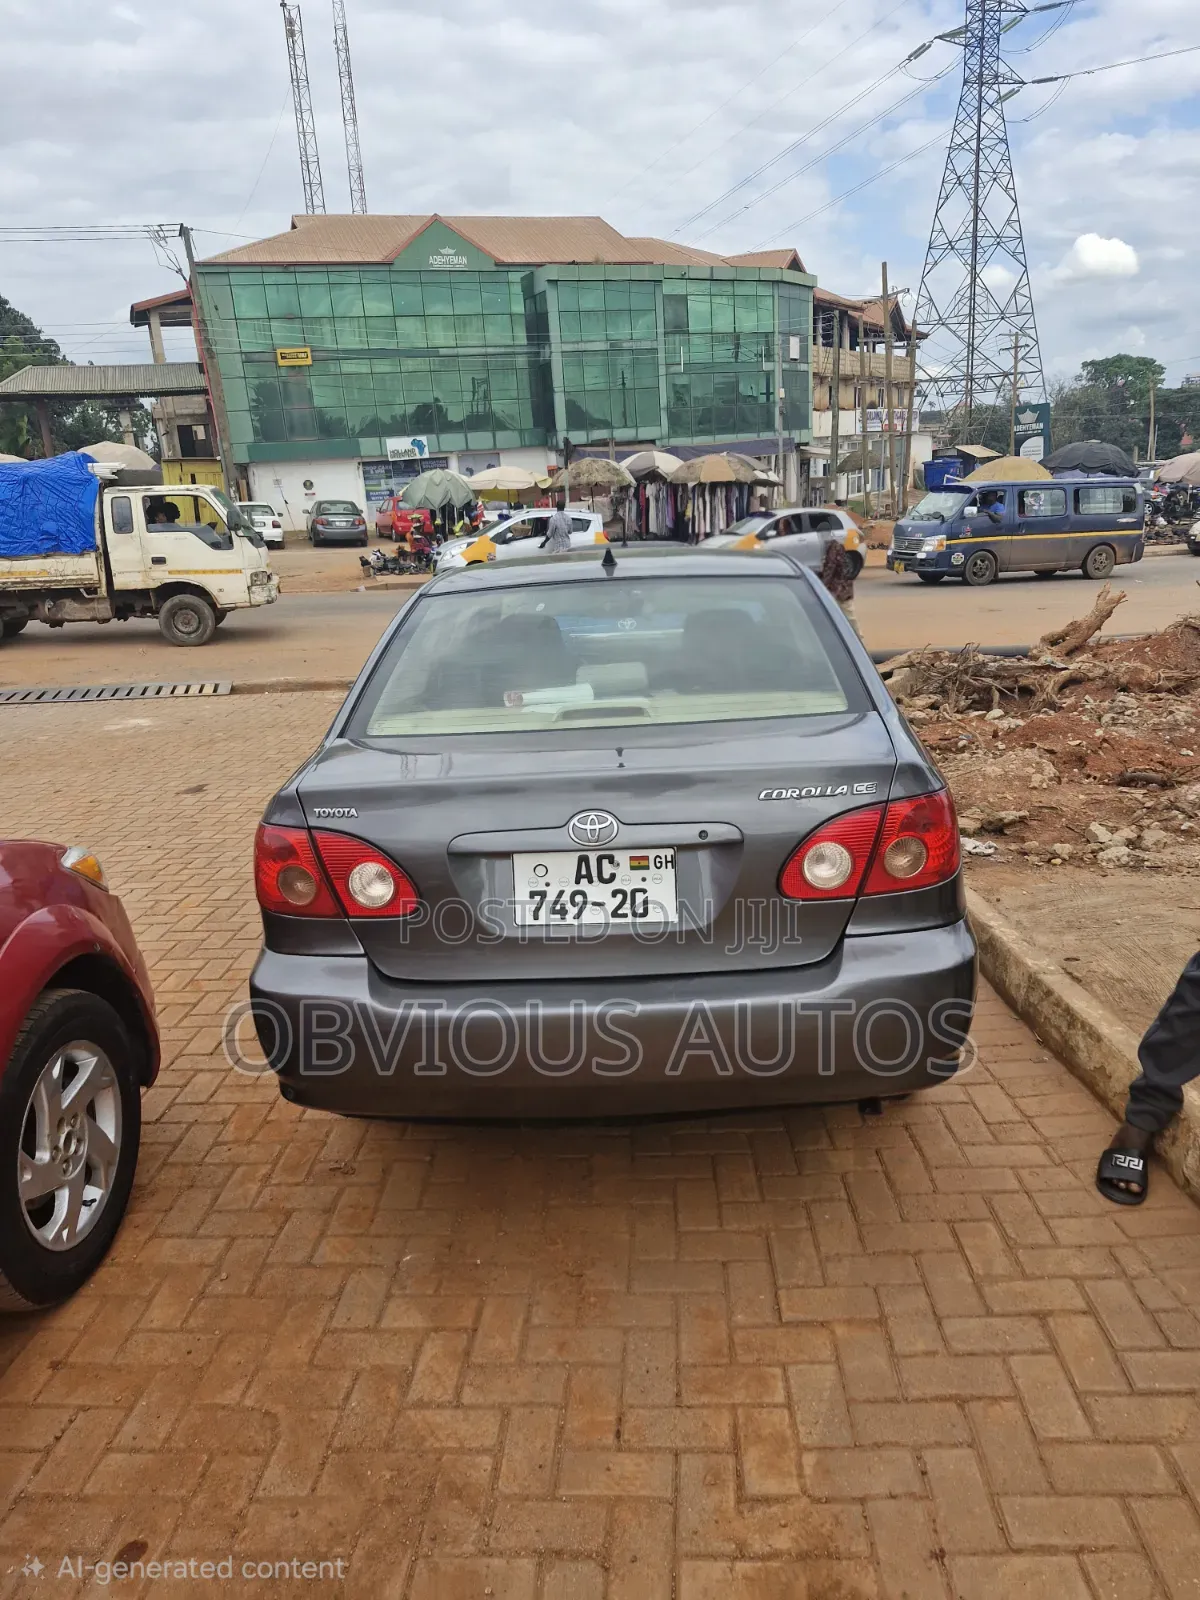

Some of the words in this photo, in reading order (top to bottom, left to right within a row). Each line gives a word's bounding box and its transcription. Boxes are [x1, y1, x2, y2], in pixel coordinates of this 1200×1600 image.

[429, 255, 467, 265] ADEHYEMAN
[389, 447, 416, 455] HOLLAND
[758, 785, 848, 800] COROLLA
[854, 782, 878, 795] CE
[313, 807, 358, 818] TOYOTA
[574, 853, 617, 885] AC
[653, 854, 675, 870] GH
